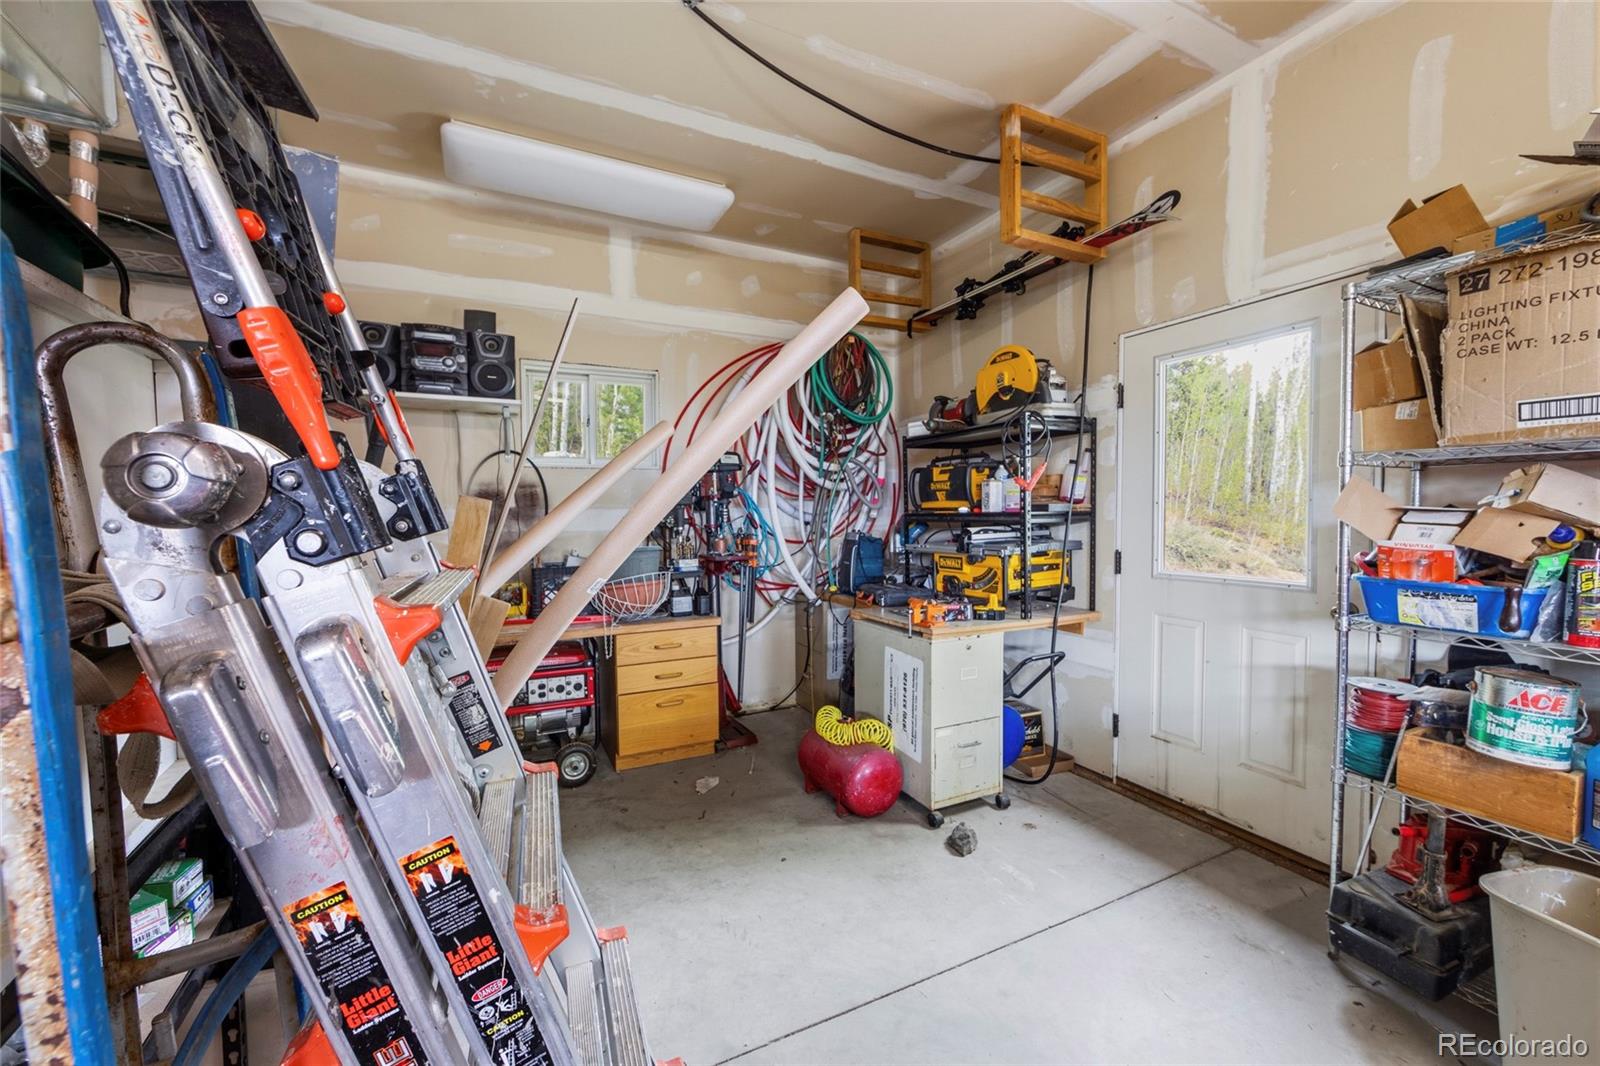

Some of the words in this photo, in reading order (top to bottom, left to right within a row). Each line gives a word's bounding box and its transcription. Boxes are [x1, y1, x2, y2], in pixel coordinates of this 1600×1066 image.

[1461, 274, 1488, 292] 27
[1460, 296, 1542, 320] LIGHTING
[1458, 316, 1510, 333] CHINA
[1457, 343, 1500, 359] CASE
[1507, 338, 1538, 351] WT:
[1551, 330, 1589, 345] 12.5
[1458, 336, 1465, 346] 2
[1471, 328, 1515, 344] PACK
[1507, 690, 1567, 712] ACE
[409, 847, 451, 870] CAUTION
[296, 894, 344, 919] CAUTION
[446, 935, 493, 964] Little
[451, 946, 498, 976] Giant
[340, 985, 392, 1018] Little
[346, 996, 398, 1029] Giant
